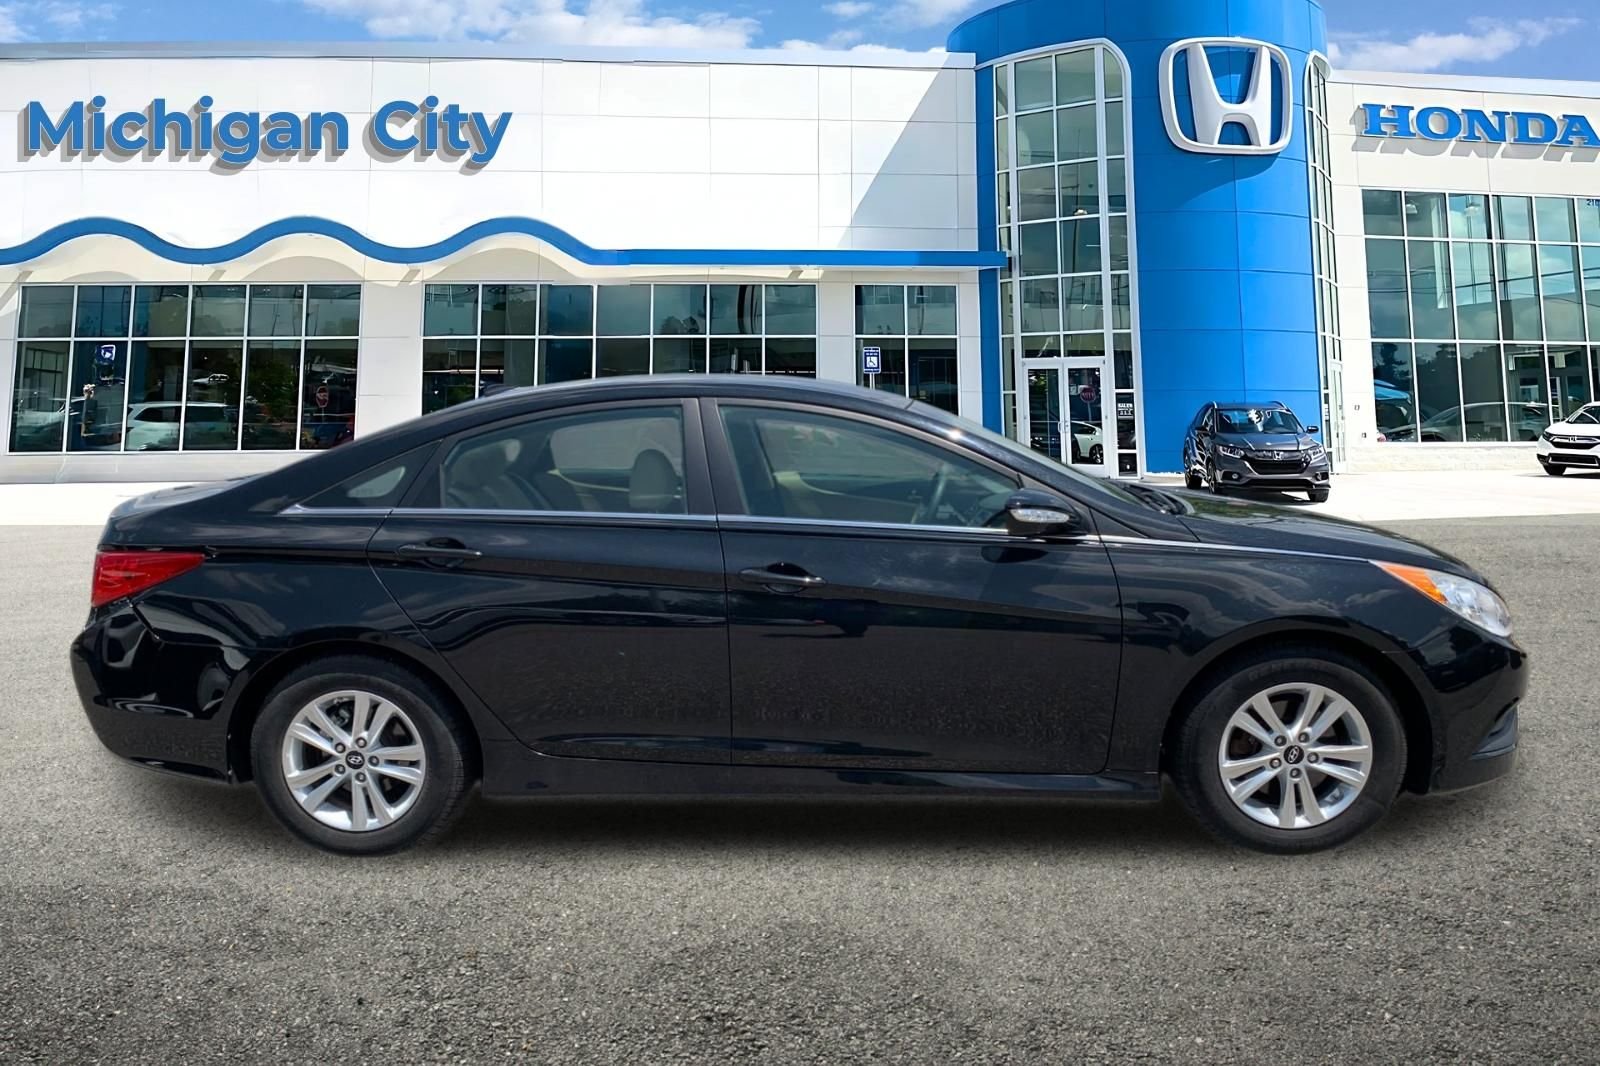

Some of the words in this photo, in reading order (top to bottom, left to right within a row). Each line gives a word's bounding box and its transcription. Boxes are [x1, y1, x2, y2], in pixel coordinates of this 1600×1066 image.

[27, 95, 349, 163] Michigan
[373, 95, 514, 163] City
[1361, 103, 1600, 147] HONDA
